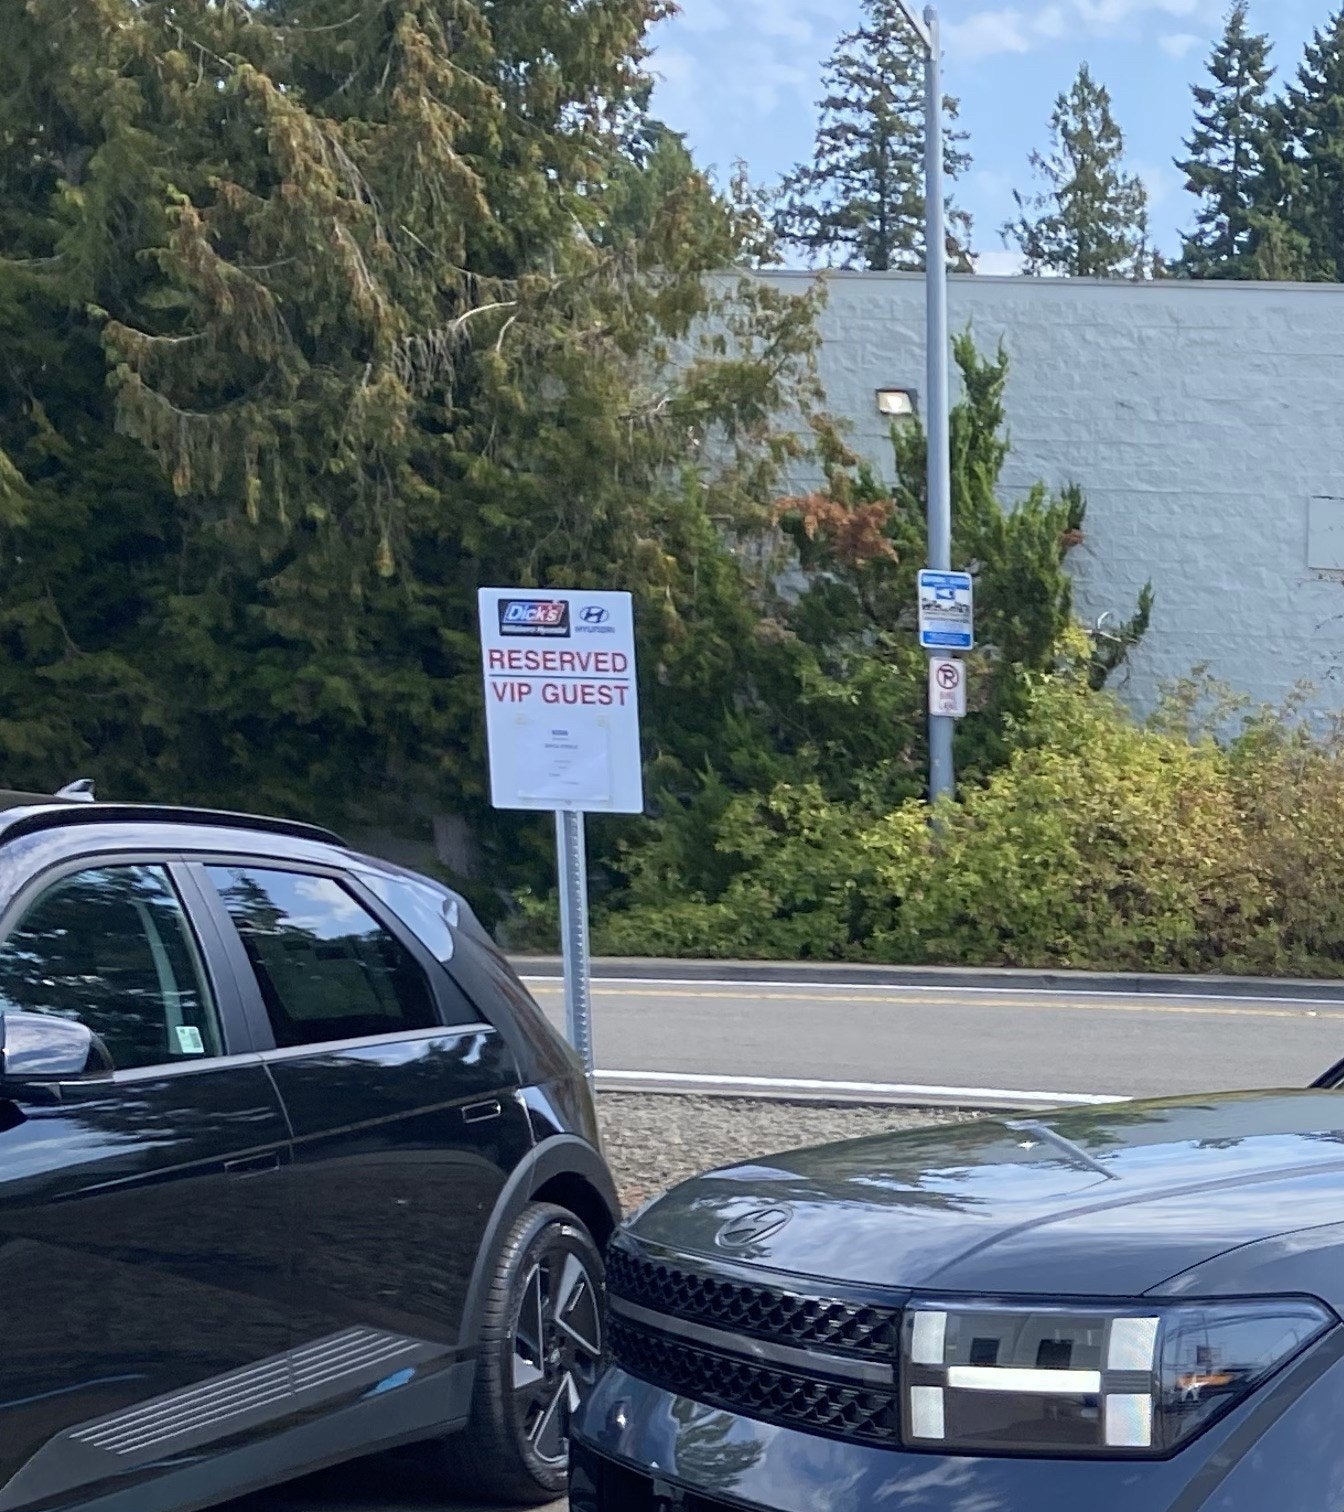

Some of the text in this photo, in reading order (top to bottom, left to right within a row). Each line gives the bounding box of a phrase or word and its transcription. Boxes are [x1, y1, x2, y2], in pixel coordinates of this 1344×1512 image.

[488, 649, 628, 672] RESERVED
[492, 681, 629, 705] VIP GUEST
